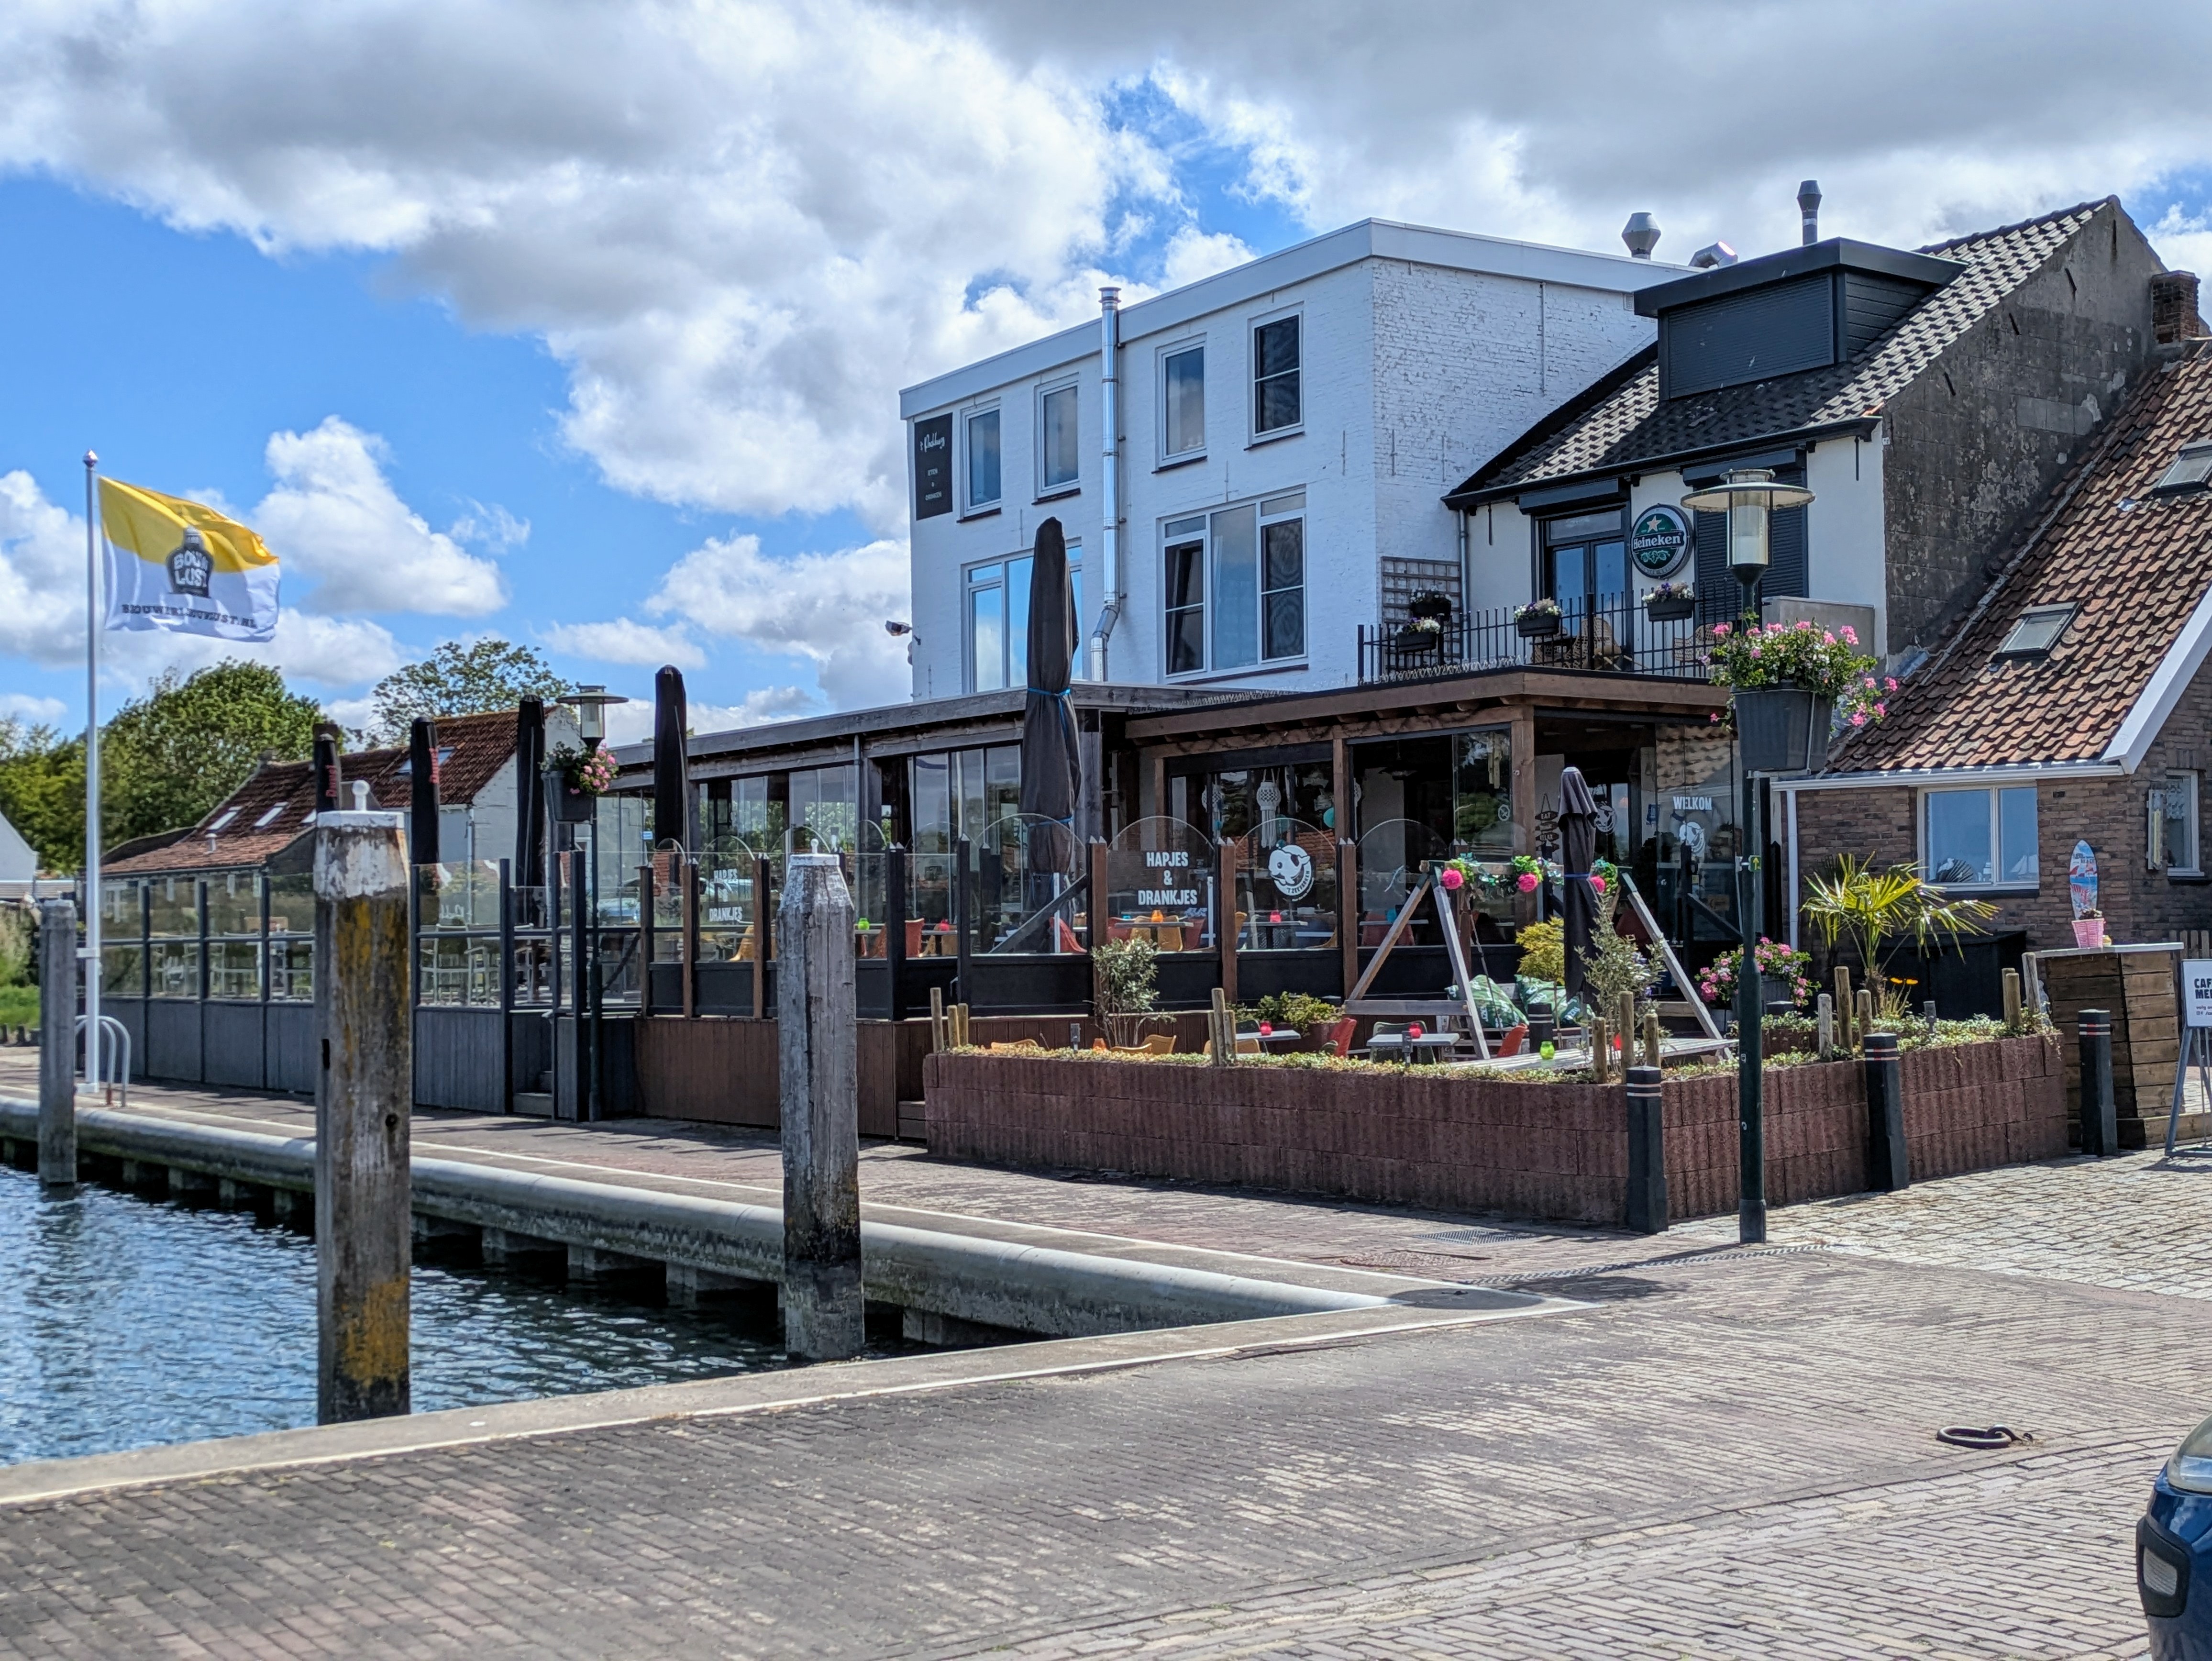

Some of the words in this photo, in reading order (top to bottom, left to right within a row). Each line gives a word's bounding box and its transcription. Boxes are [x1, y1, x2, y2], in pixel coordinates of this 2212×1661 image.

[1633, 534, 1681, 550] Heineken
[1673, 796, 1712, 810] WELKOM
[1146, 852, 1188, 867] HAPJES
[1163, 870, 1172, 886] &
[1138, 889, 1197, 905] DRANKJES
[2194, 978, 2212, 989] CAF
